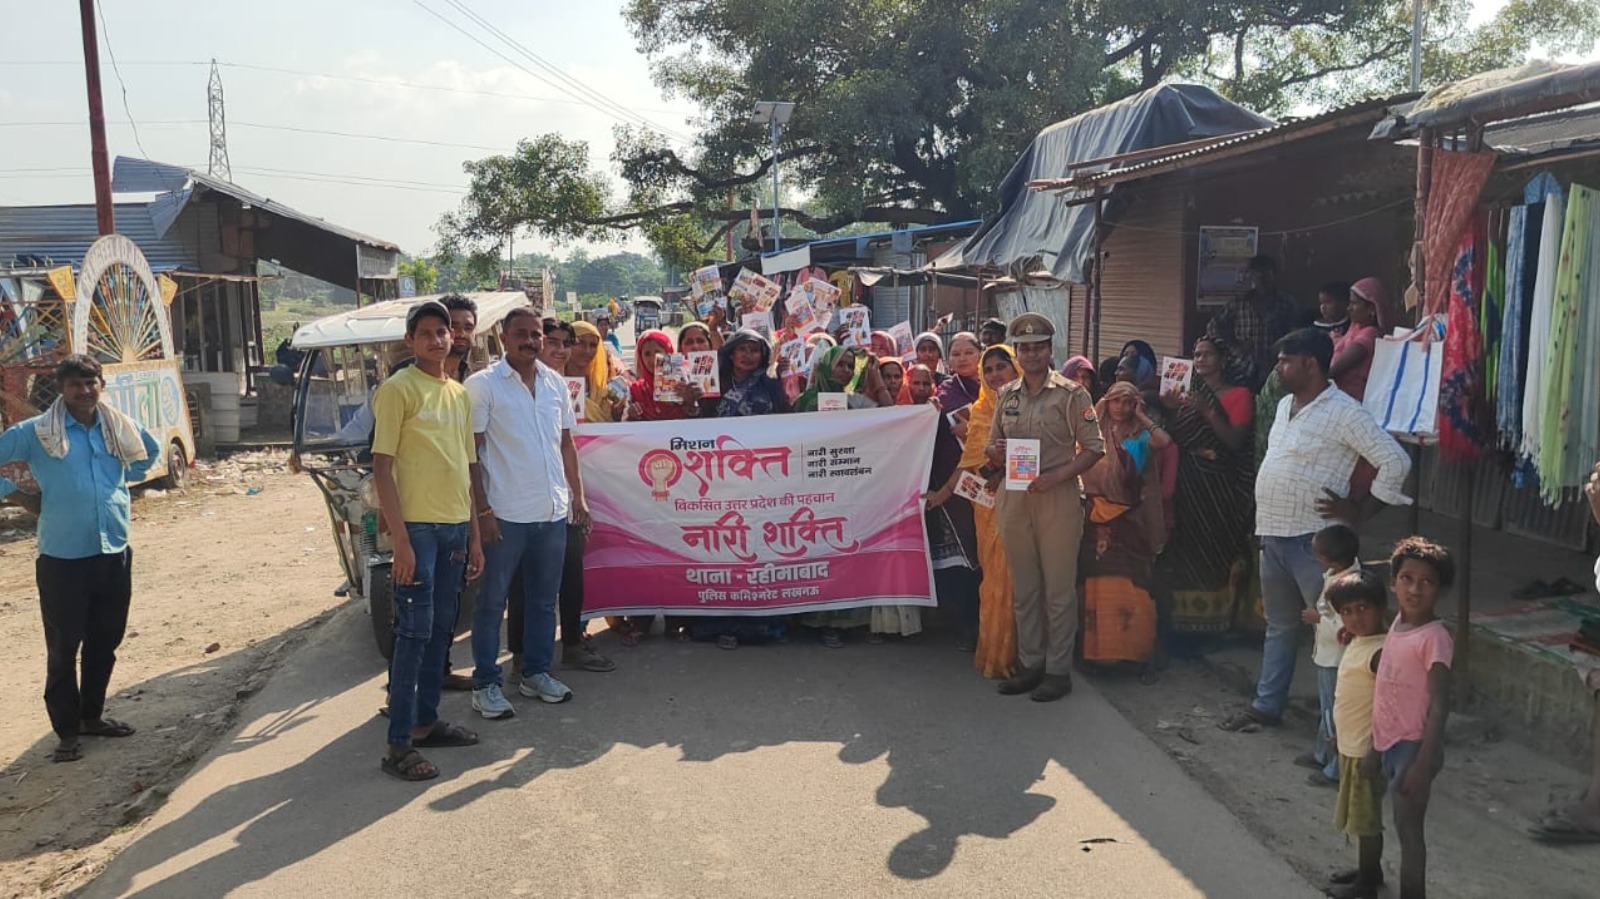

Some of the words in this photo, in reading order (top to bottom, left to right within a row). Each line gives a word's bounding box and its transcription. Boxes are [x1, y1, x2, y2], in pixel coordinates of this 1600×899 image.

[670, 437, 715, 450] मिशन
[807, 446, 826, 456] नारी
[829, 446, 856, 458] सुरक्षा
[683, 434, 792, 497] शक्ति
[807, 457, 826, 467] नारी
[829, 457, 861, 466] सम्मान
[807, 468, 827, 478] नारी
[829, 466, 872, 477] स्वावलंबन
[674, 498, 722, 512] विकसित
[723, 498, 748, 511] उत्तर
[750, 494, 777, 511] प्रदेश
[779, 492, 795, 506] की
[796, 492, 836, 505] पहचान
[679, 510, 758, 563] नारी
[762, 506, 861, 558] शक्ति
[685, 567, 732, 585] थाना
[745, 561, 830, 585] रहीमाबाद
[697, 588, 727, 603] पुलिस
[729, 587, 779, 602] कमिश्नरेट
[781, 586, 820, 599] लखनऊ
